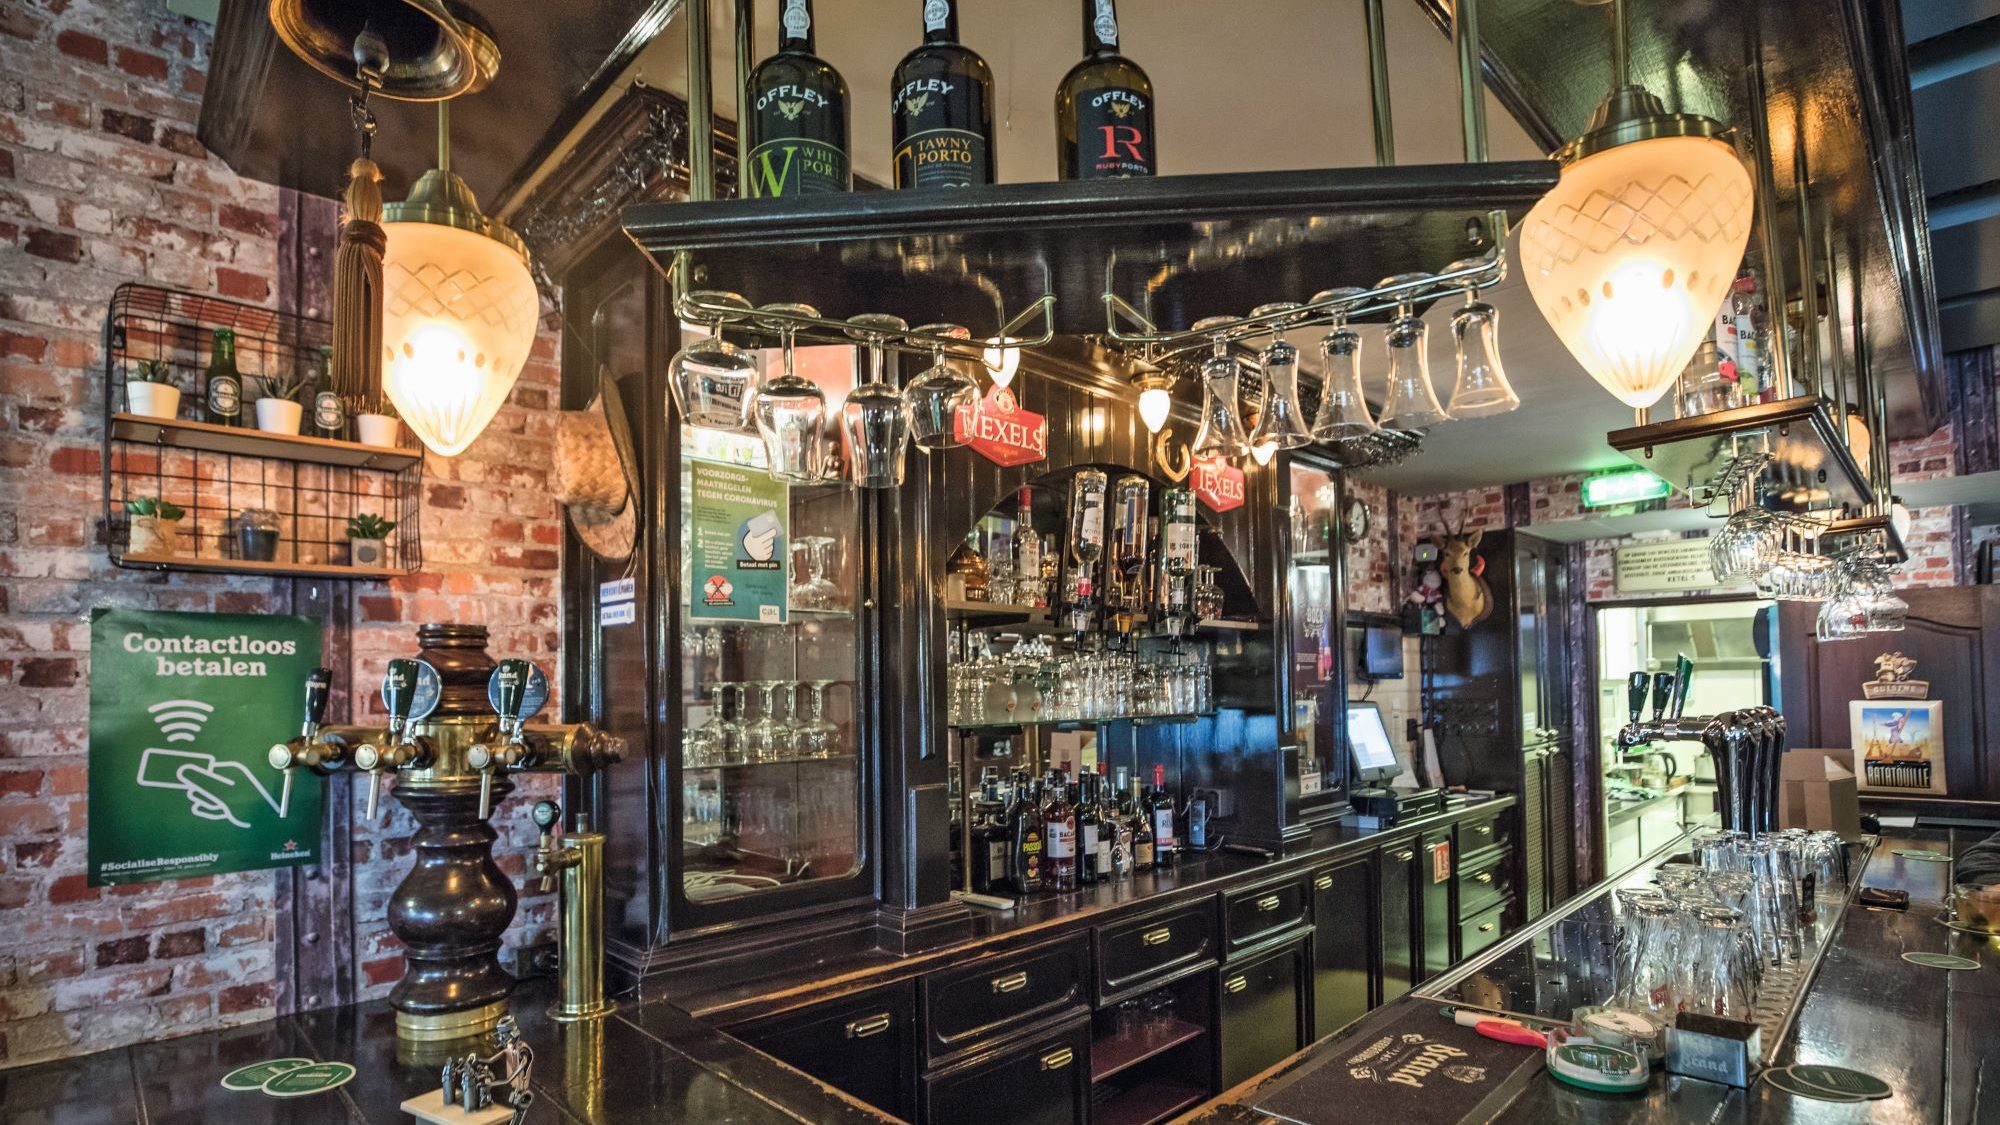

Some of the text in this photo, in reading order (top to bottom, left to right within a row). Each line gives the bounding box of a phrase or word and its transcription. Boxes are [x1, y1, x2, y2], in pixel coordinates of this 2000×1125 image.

[756, 84, 829, 111] OFFLEY
[892, 78, 954, 114] OFFLEY
[1091, 90, 1145, 110] OFFLEY
[916, 137, 971, 152] TAWNY
[1097, 125, 1145, 162] R
[918, 148, 972, 165] PORTO
[958, 407, 1043, 453] TEXELS
[696, 467, 749, 482] VOORZORGS-
[1194, 463, 1243, 501] TEXELS
[696, 478, 752, 493] MAATREGELEN
[696, 489, 778, 508] TEGEN CORONAVIRUS
[123, 632, 296, 655] Contactloos
[155, 656, 267, 676] betalen
[1867, 765, 1929, 788] RATATOUILLE
